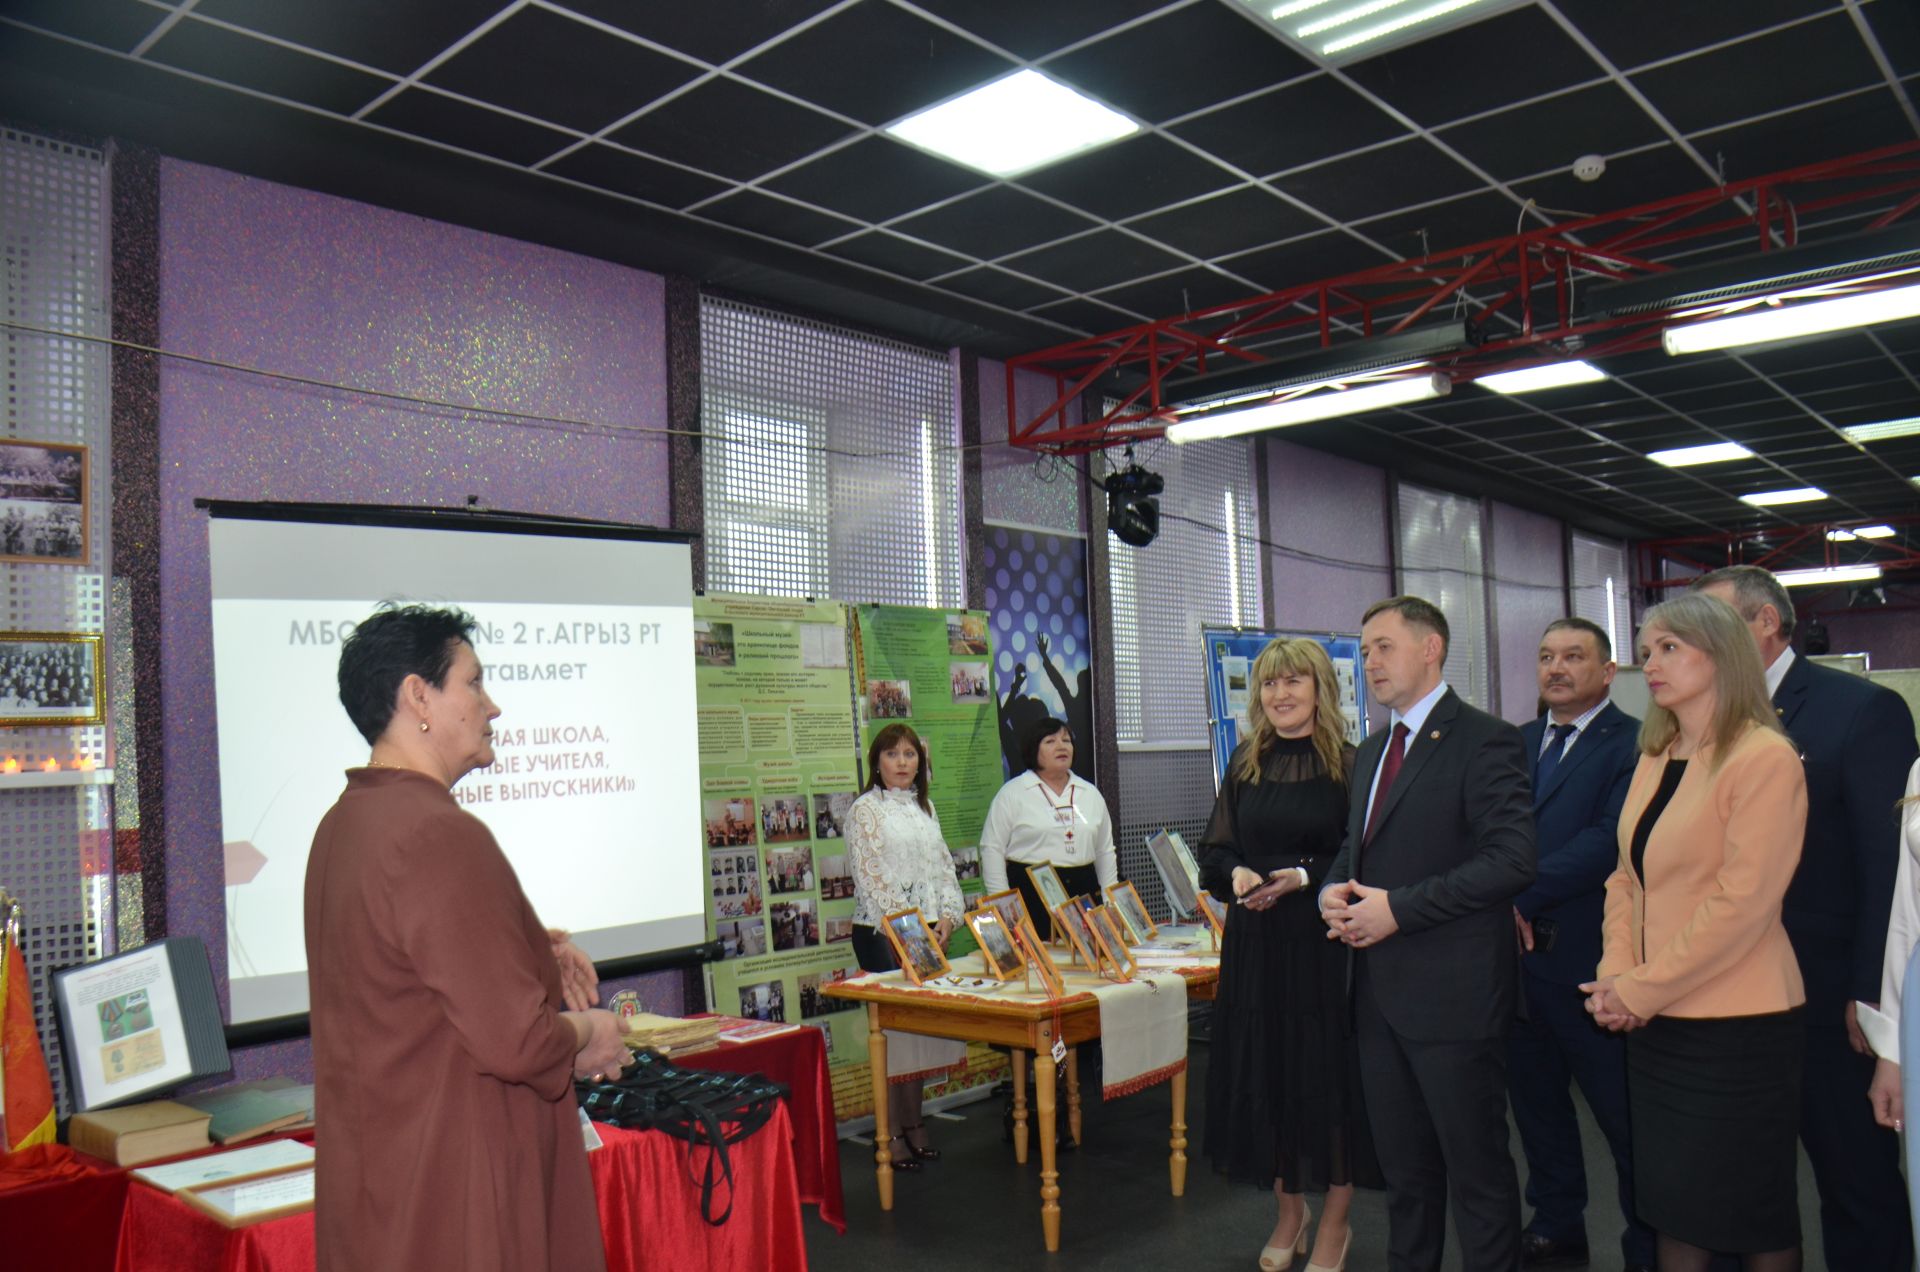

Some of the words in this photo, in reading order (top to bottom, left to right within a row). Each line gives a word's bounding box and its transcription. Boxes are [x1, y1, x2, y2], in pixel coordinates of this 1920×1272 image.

[289, 620, 357, 646] МБО
[513, 621, 527, 645] 2
[640, 623, 661, 645] РТ
[484, 663, 587, 682] тавляет
[491, 729, 526, 747] НАЯ
[533, 725, 610, 746] ШКОЛА,
[526, 751, 610, 774] УЧИТЕЛЯ,
[452, 785, 493, 804] НЫЕ
[500, 776, 636, 801] ВЫПУСКНИКИ»
